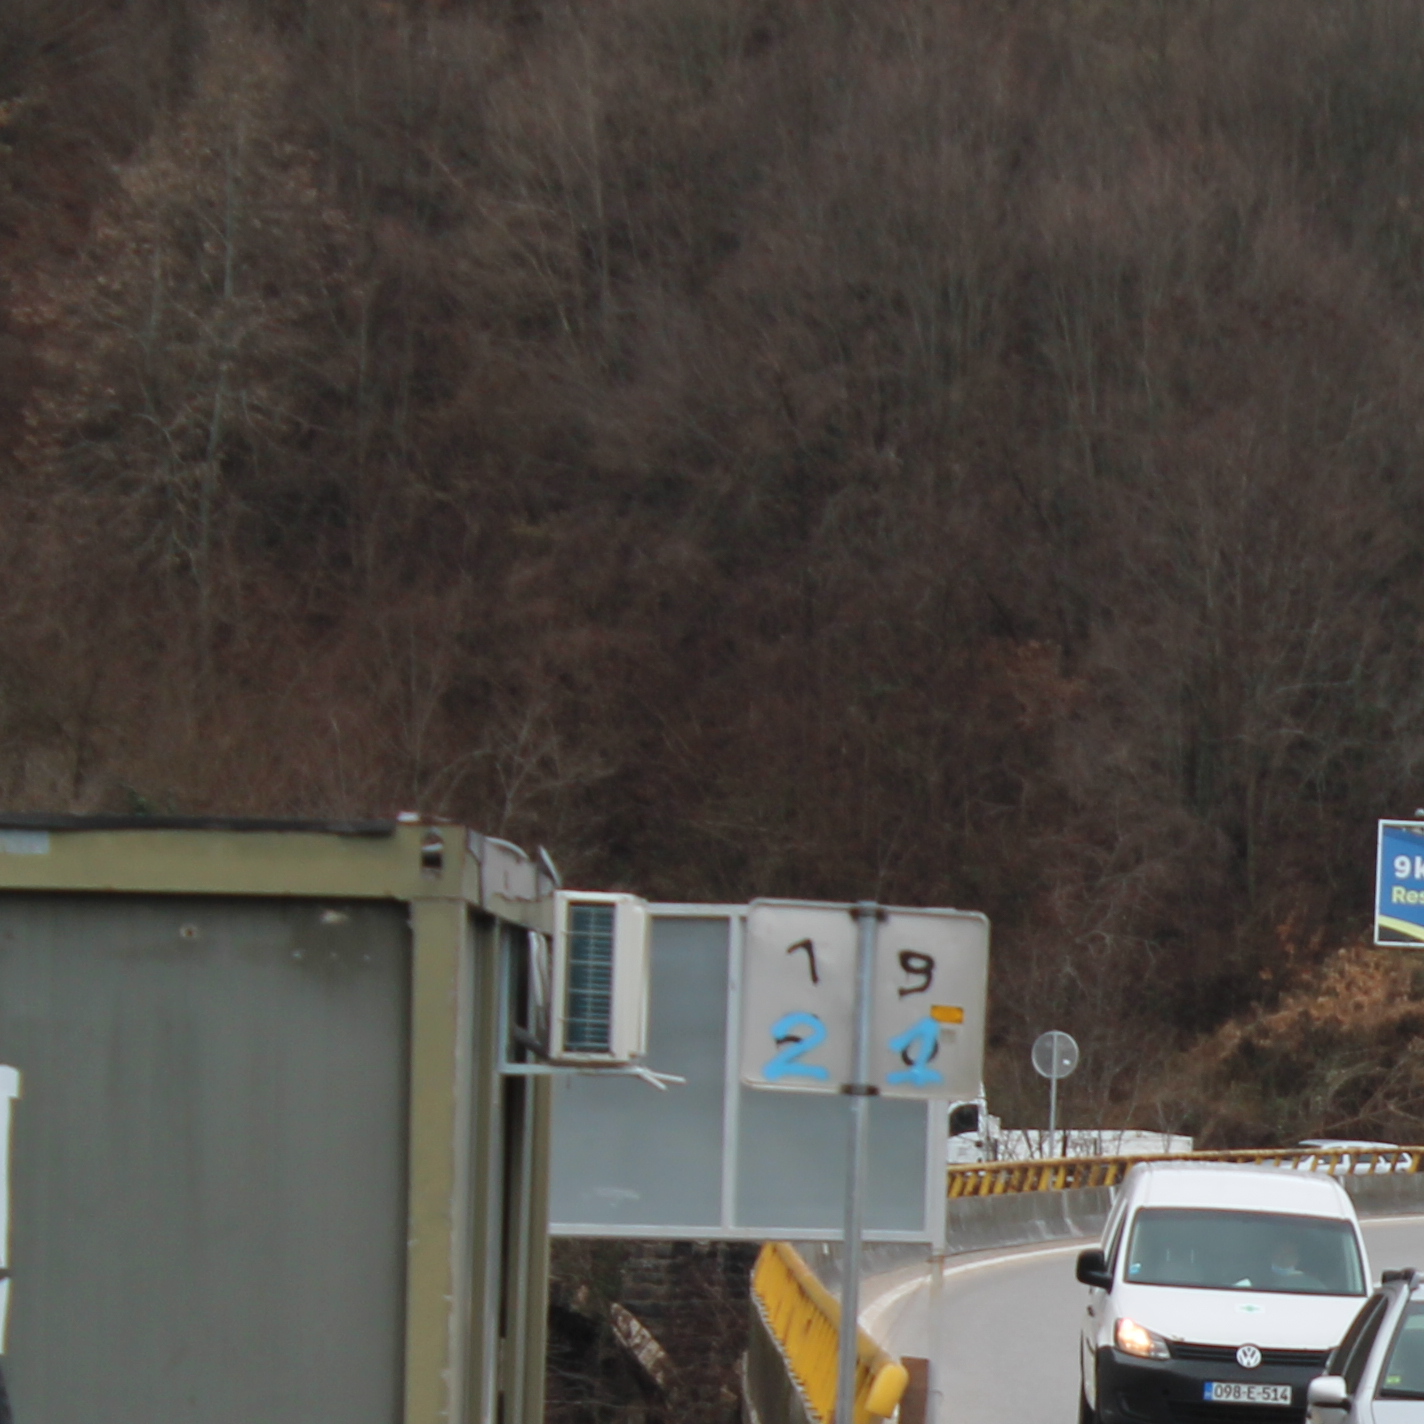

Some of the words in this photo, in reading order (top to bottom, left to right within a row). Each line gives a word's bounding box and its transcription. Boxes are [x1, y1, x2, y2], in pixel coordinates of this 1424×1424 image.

[1394, 855, 1411, 879] 9
[762, 1010, 829, 1082] 2
[1213, 1384, 1289, 1402] 098-E-514
